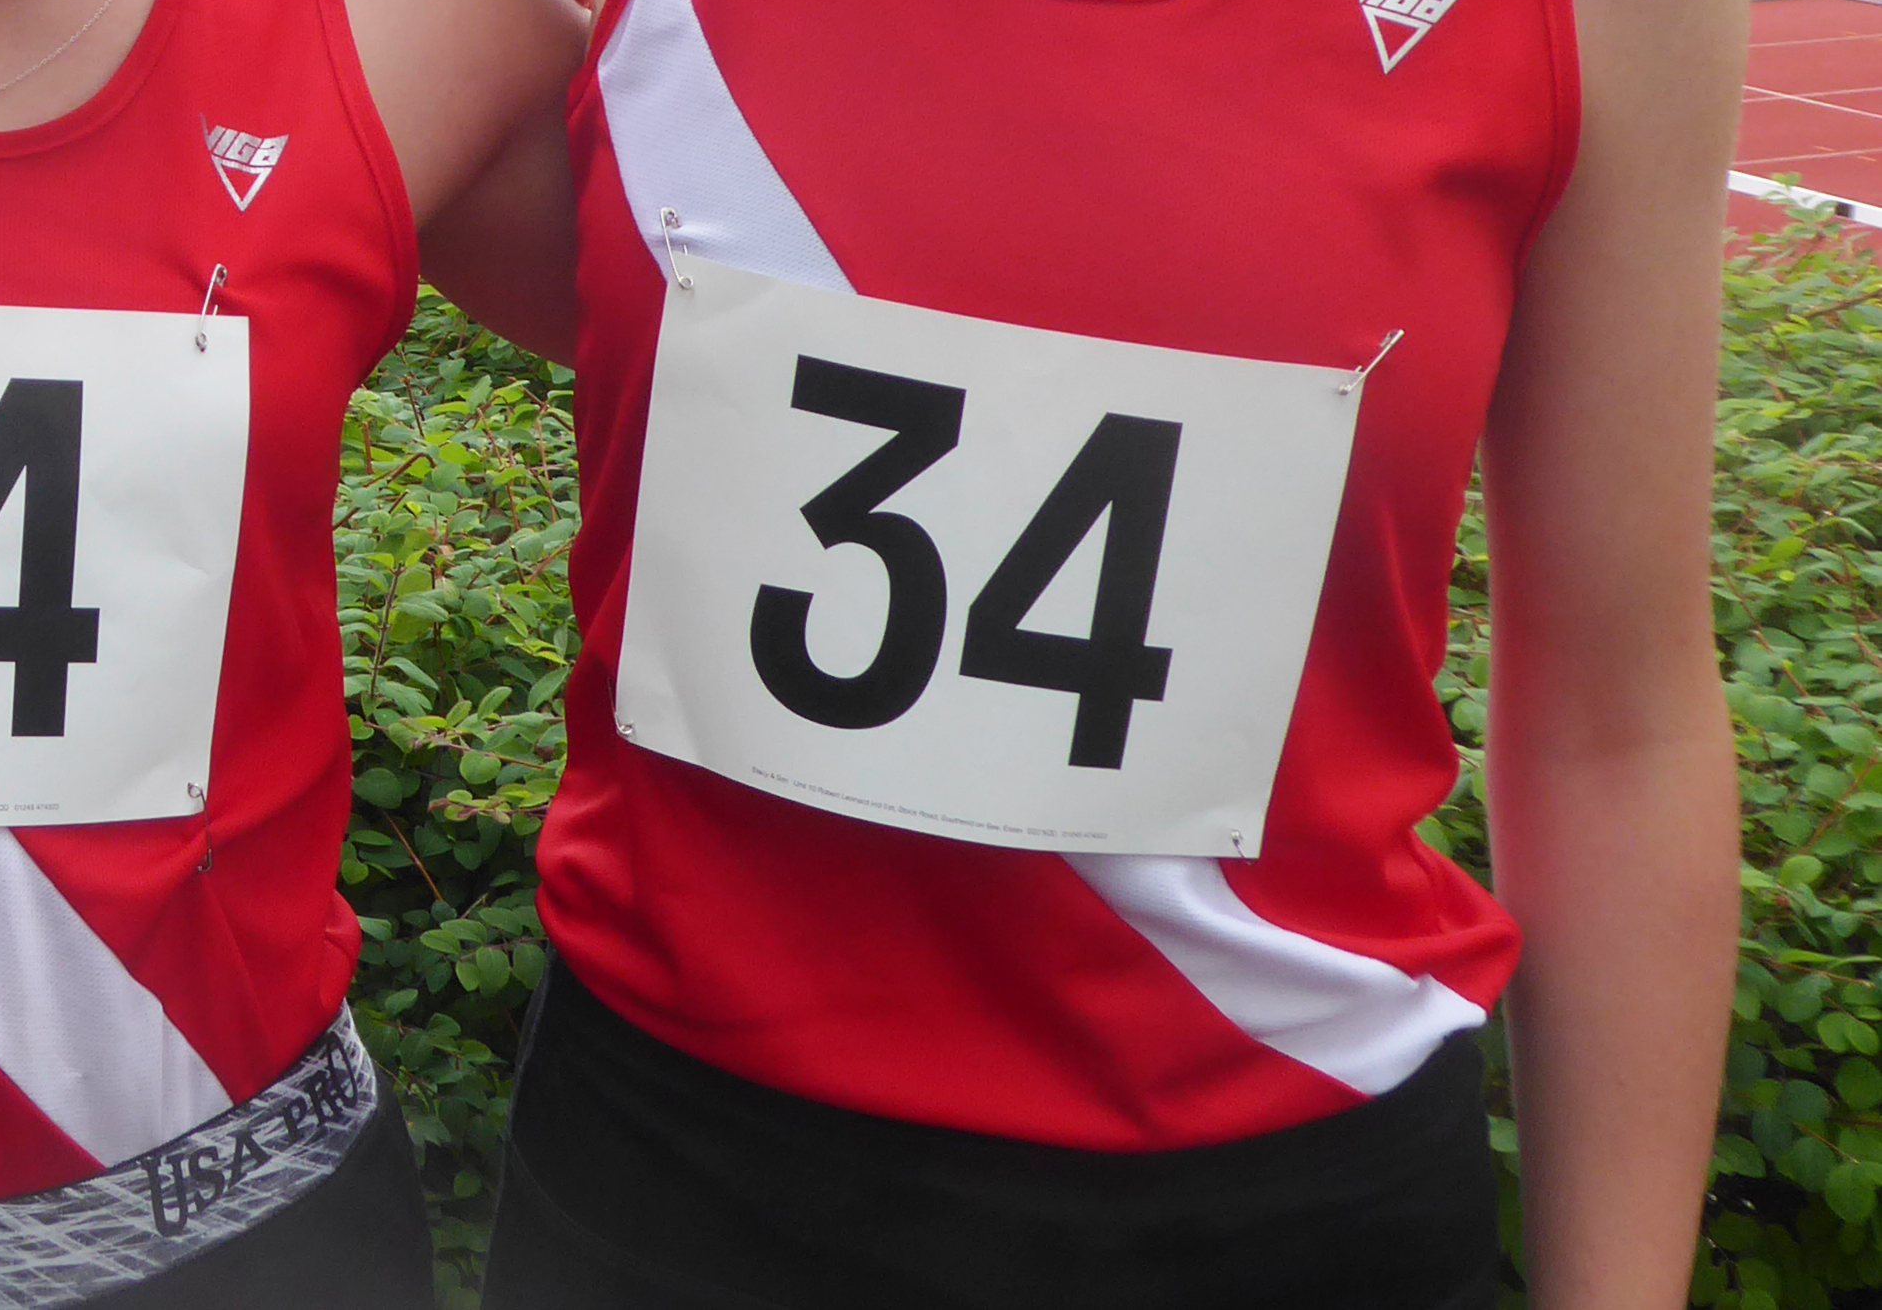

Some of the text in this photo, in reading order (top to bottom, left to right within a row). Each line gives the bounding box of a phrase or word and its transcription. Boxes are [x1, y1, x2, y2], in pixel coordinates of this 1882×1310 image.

[750, 354, 1183, 770] 34
[140, 1031, 359, 1238] USA PRO
